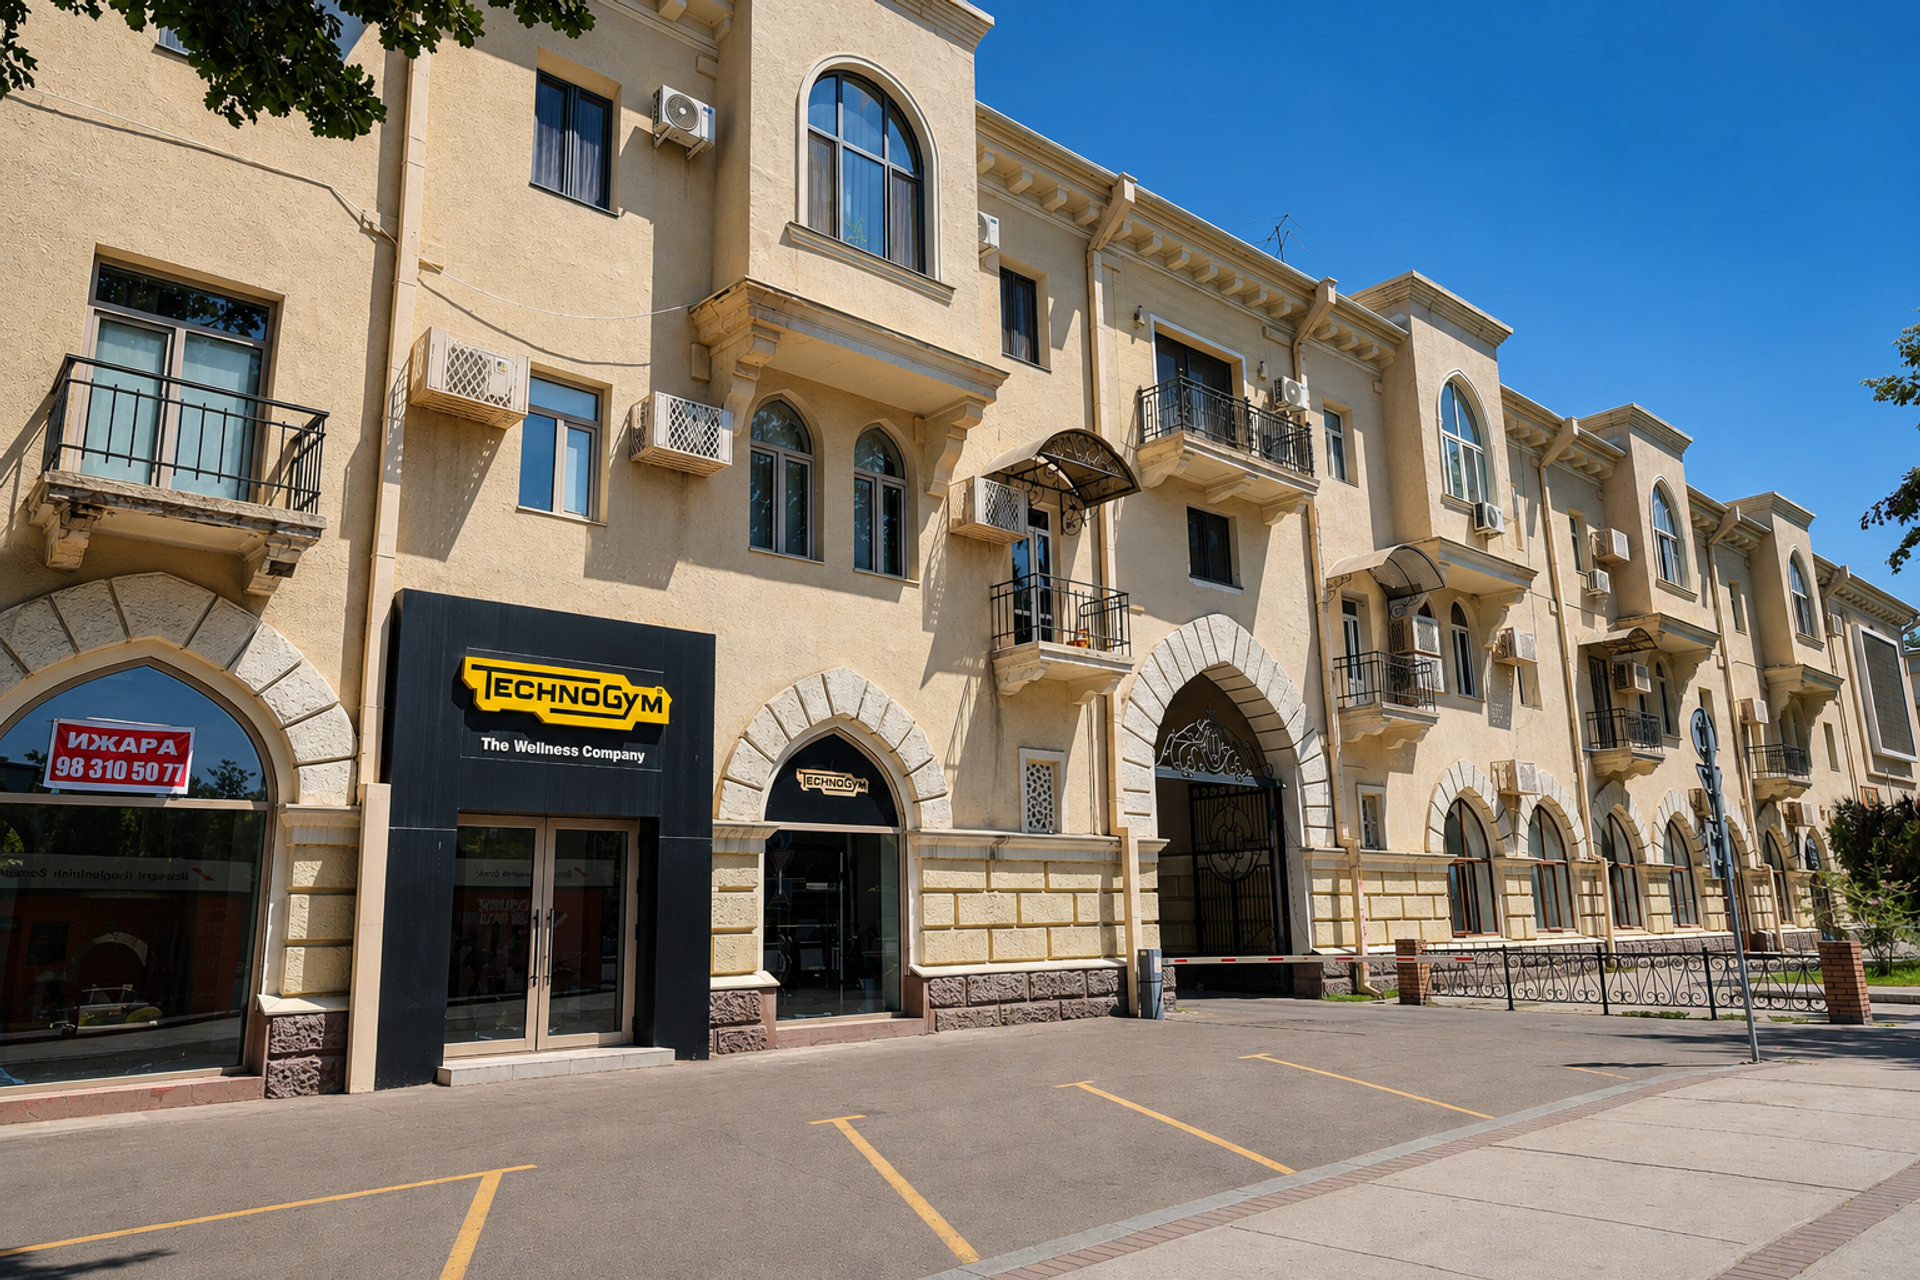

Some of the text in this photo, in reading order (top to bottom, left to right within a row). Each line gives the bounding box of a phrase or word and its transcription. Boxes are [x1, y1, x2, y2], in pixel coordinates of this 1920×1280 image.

[471, 664, 663, 720] TECHNOGYM
[67, 731, 178, 756] ИЖАРА
[481, 736, 645, 764] The Wellness Company
[55, 755, 185, 783] 98 310 50 77
